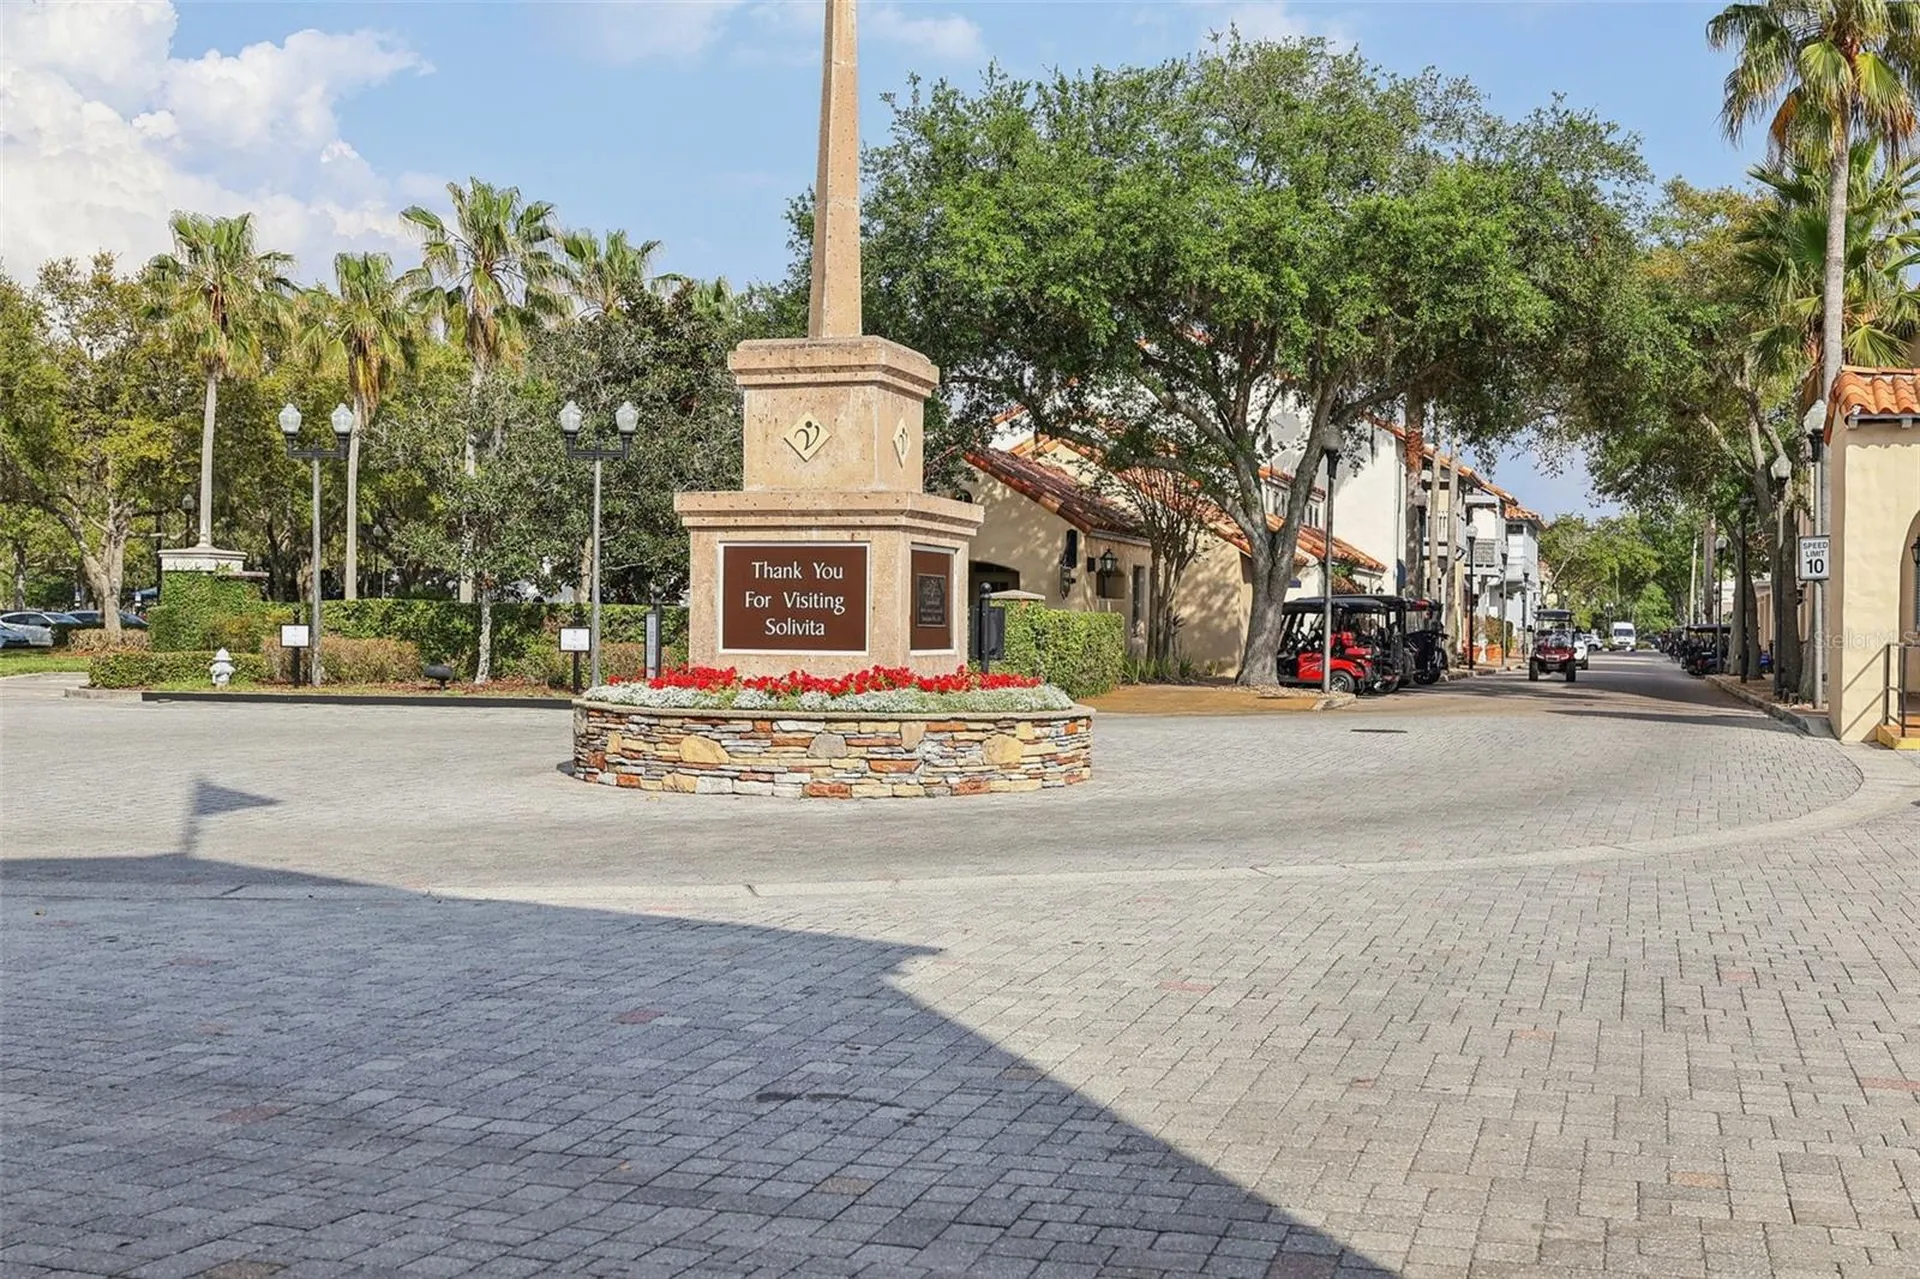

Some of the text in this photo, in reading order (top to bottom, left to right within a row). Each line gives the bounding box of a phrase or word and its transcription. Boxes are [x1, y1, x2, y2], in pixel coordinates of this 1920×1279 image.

[1803, 541, 1828, 549] SPEED
[752, 561, 843, 579] Thank You
[1806, 558, 1824, 574] 10
[745, 591, 845, 615] For Visiting
[765, 618, 825, 635] Solivita
